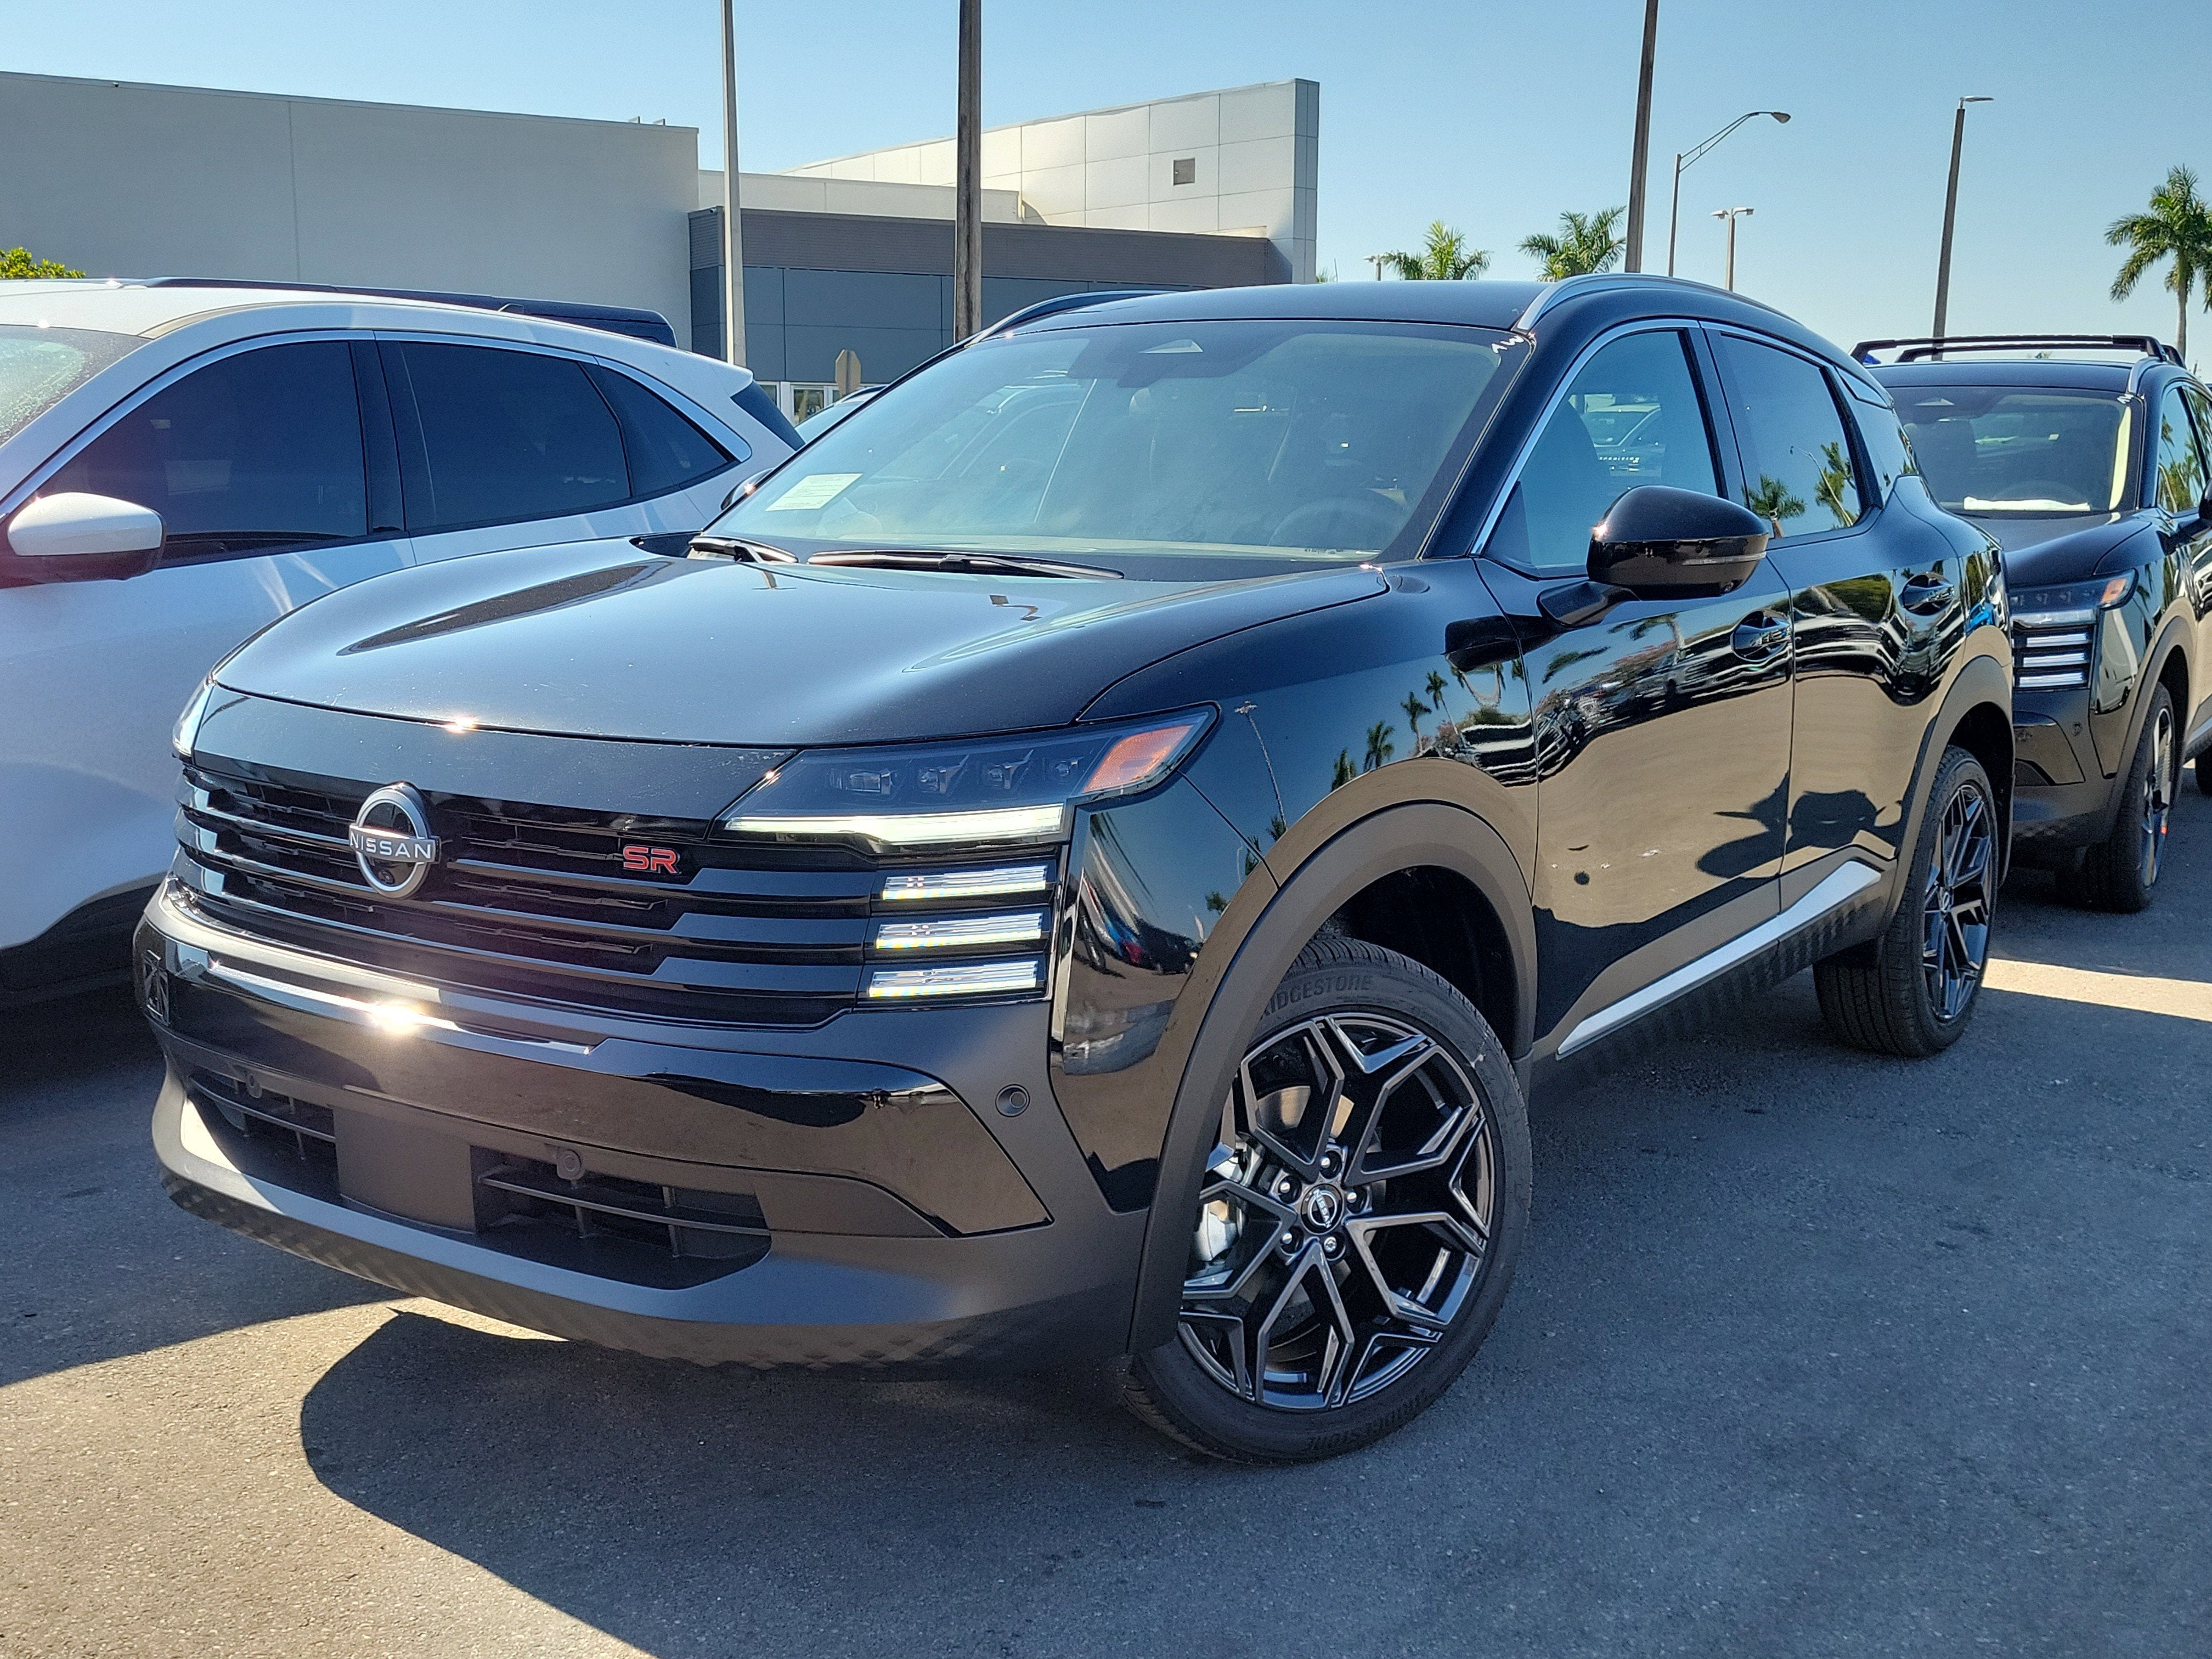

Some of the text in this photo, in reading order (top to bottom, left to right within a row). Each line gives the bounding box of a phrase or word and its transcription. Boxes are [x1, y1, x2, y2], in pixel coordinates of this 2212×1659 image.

[349, 830, 431, 859] NISSAN
[623, 845, 678, 874] SR
[1260, 974, 1373, 1017] IDGESTONE
[1313, 1188, 1332, 1228] NISSAN
